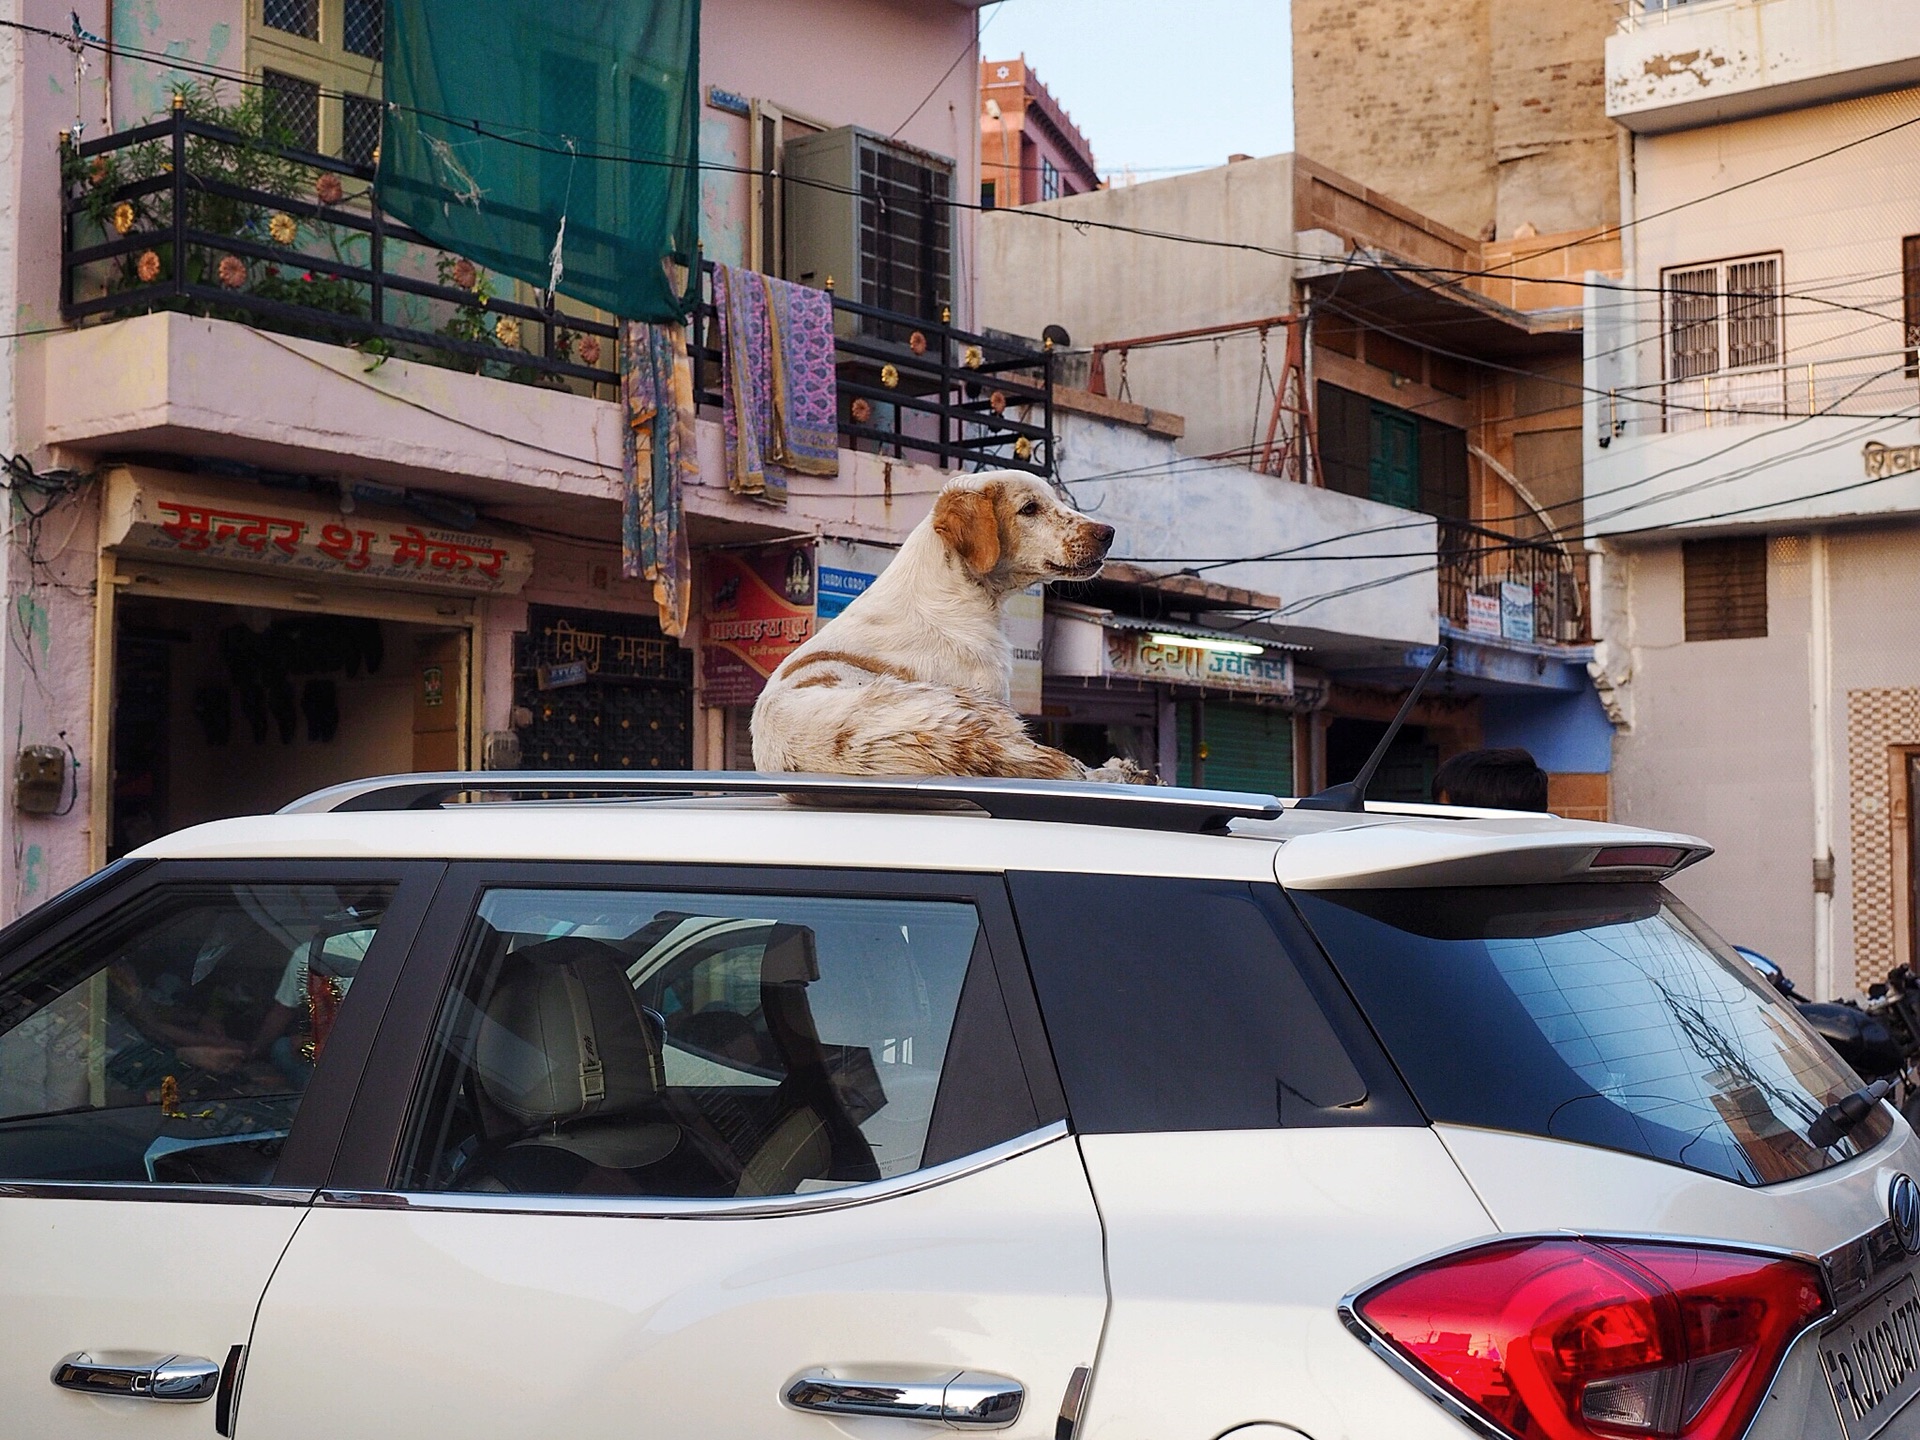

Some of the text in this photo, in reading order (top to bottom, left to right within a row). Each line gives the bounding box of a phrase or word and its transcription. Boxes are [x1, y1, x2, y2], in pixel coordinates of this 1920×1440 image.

[158, 501, 308, 554] सुन्दर
[317, 523, 377, 571] शु
[390, 526, 509, 579] मेकर
[611, 635, 669, 669] भवन
